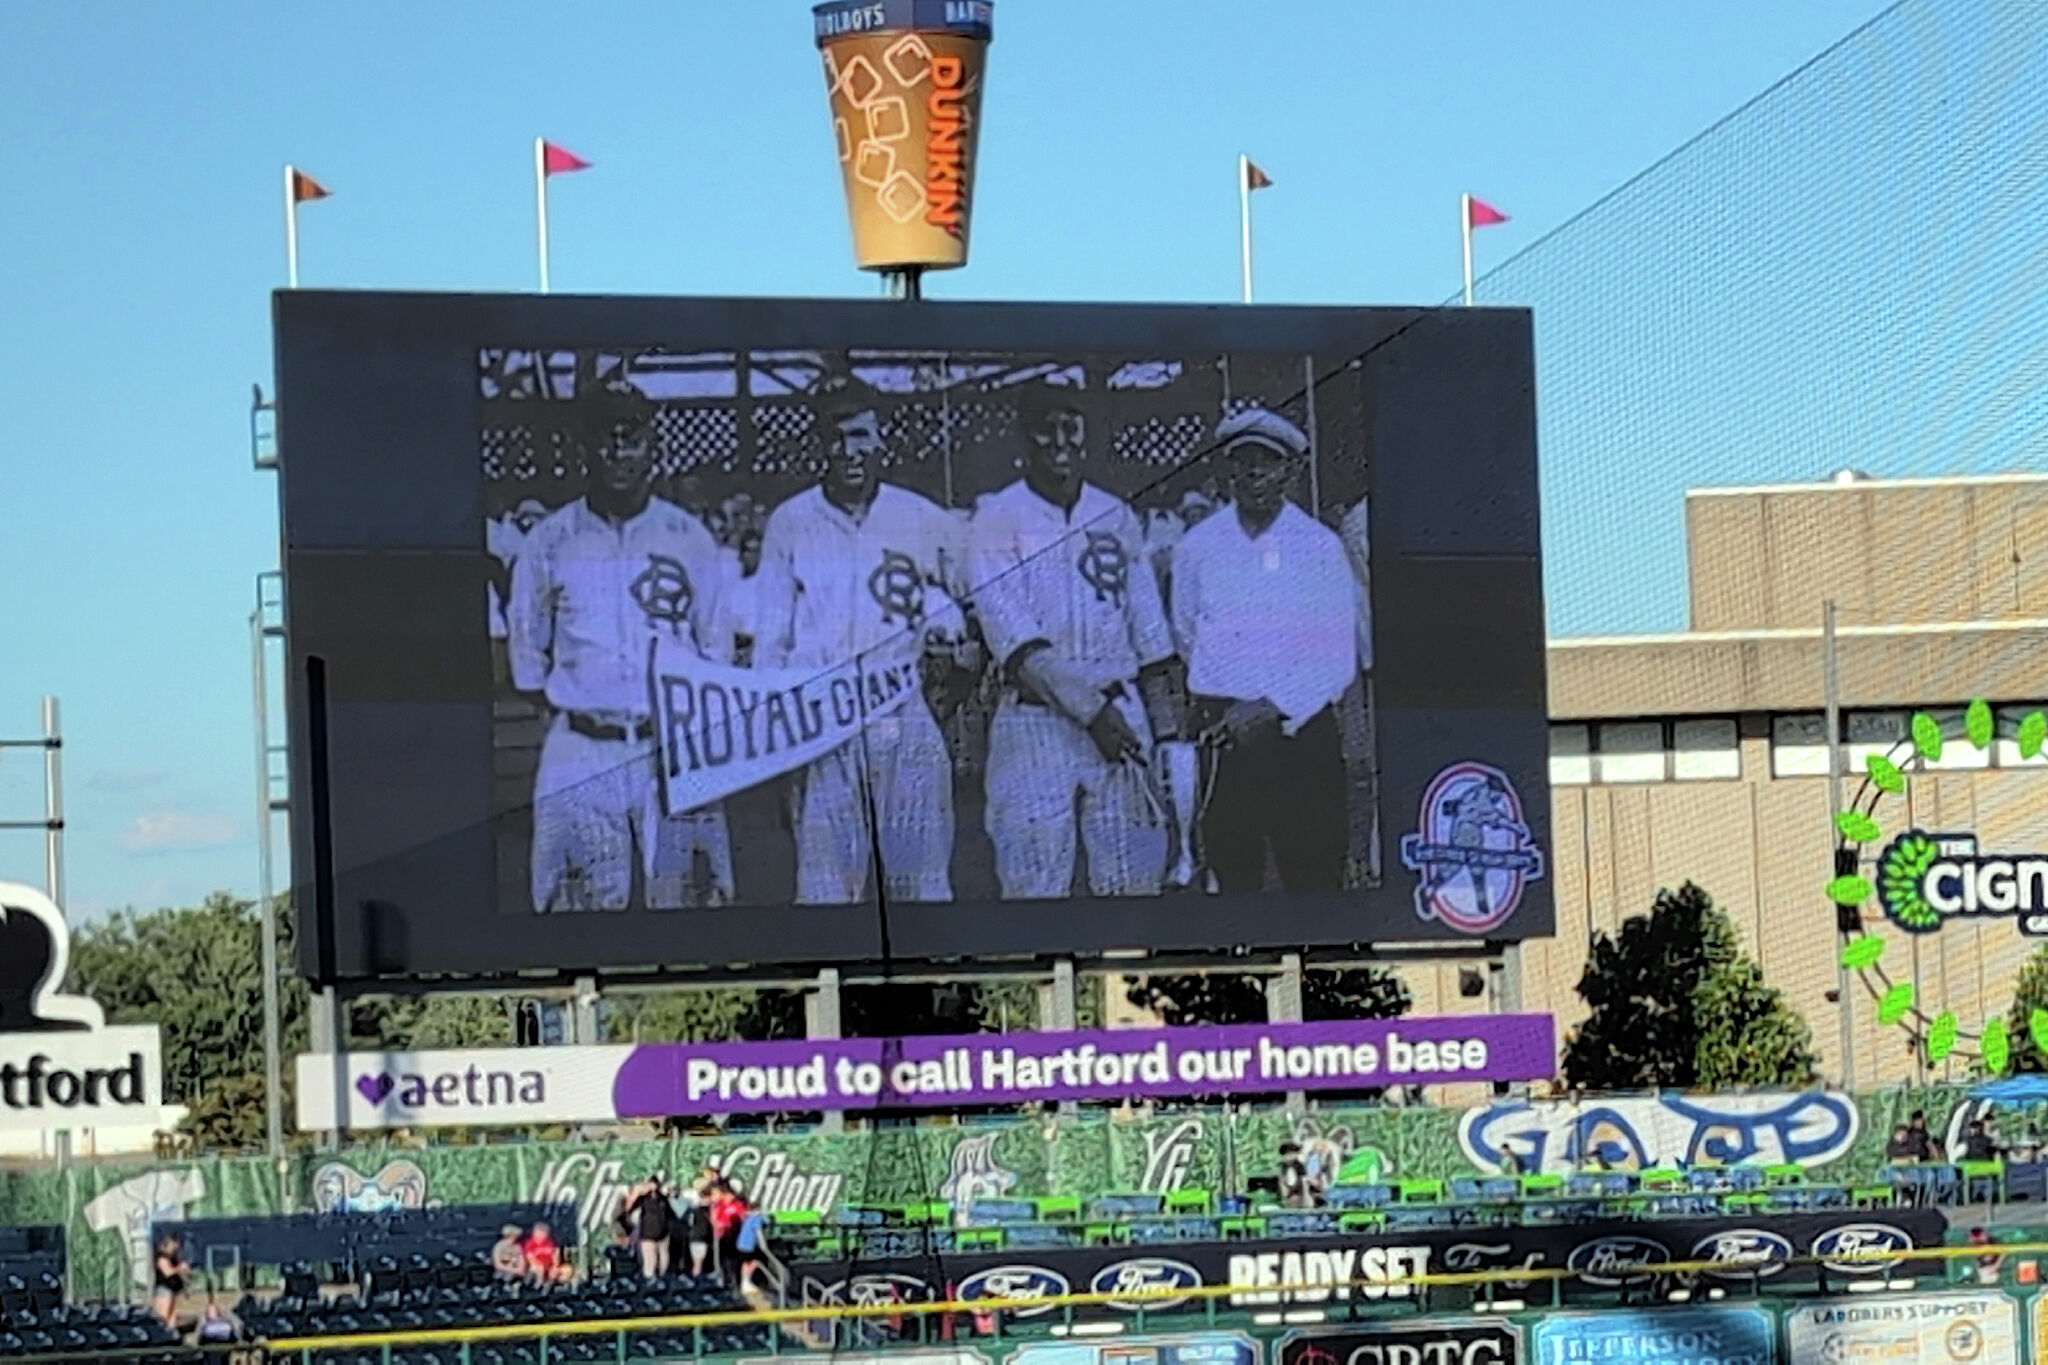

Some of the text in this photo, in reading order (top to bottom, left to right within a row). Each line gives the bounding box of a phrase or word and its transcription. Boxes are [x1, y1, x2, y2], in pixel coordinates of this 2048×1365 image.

[661, 673, 823, 778] ROYAL
[0, 1053, 145, 1109] tford
[400, 1062, 545, 1108] aetna
[687, 1032, 1488, 1101] Proud to call Hartford our home base
[1228, 1246, 1432, 1306] READY SET
